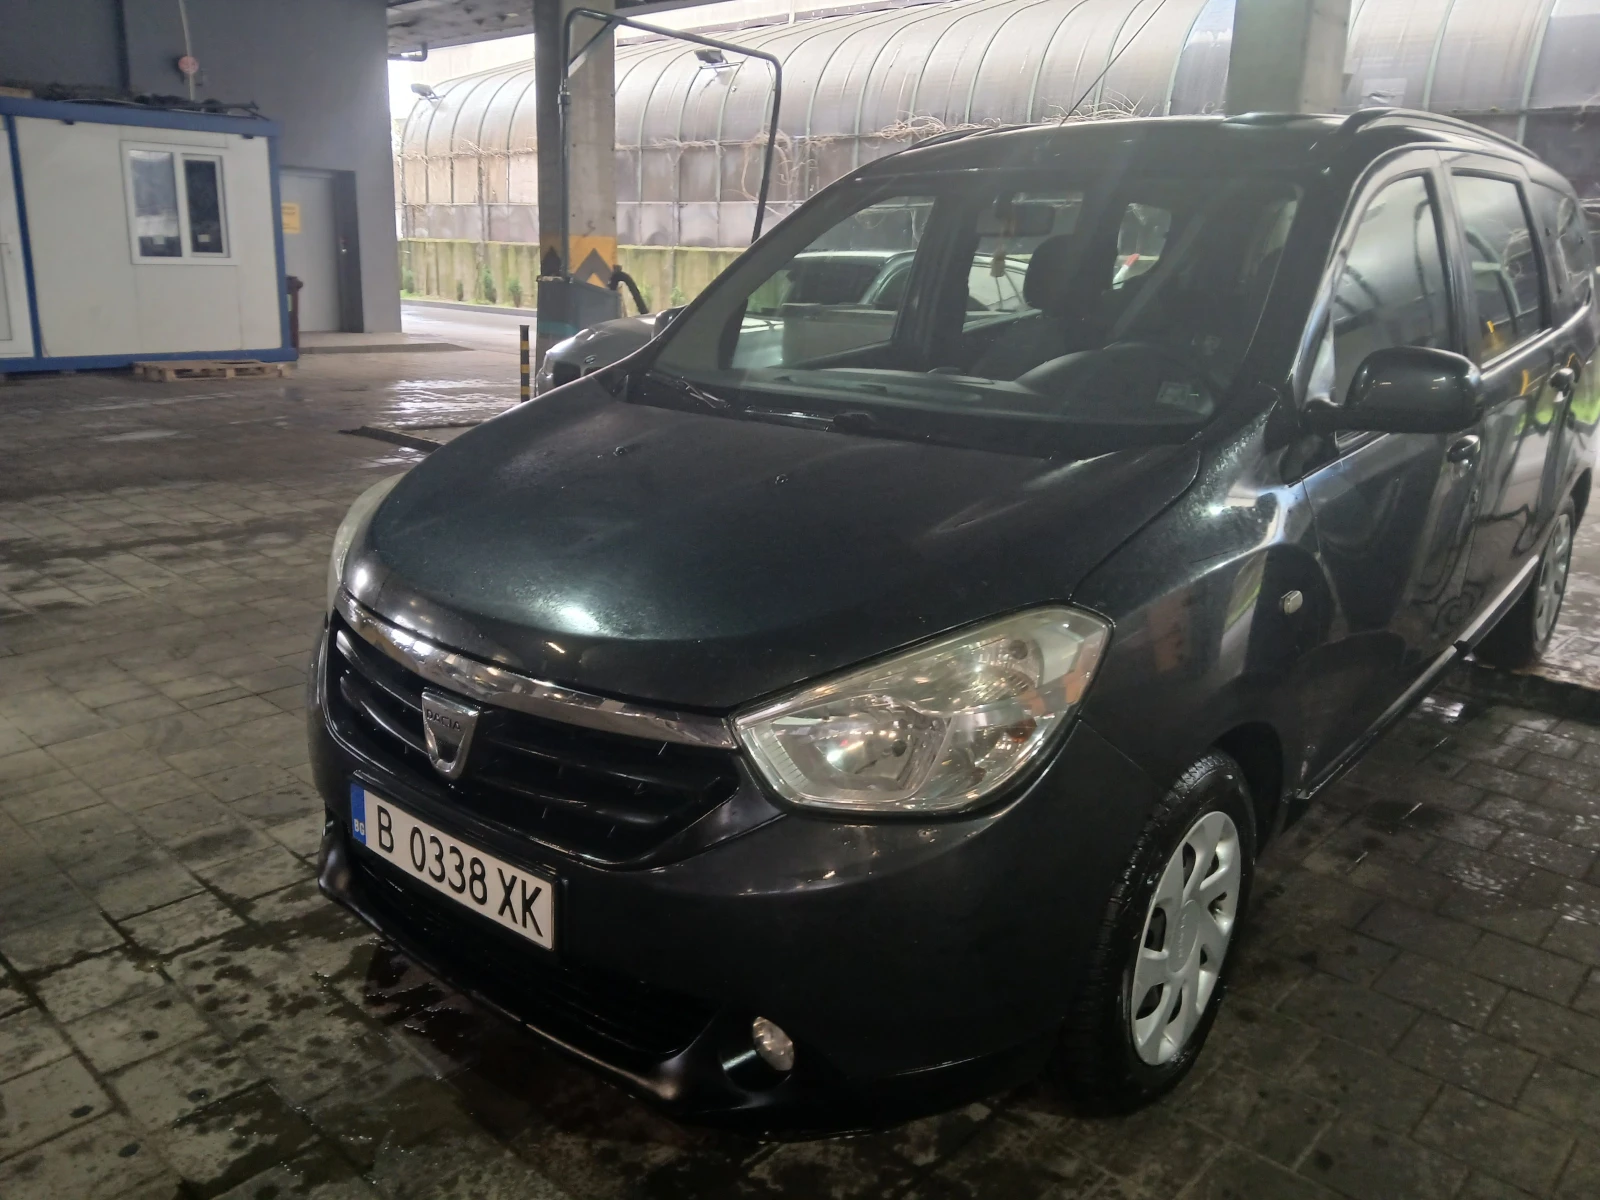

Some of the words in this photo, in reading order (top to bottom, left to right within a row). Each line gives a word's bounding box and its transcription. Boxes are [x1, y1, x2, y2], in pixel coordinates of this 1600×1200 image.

[426, 708, 462, 732] DACIA
[353, 818, 365, 836] BG
[377, 804, 394, 853] B
[410, 826, 488, 906] 0338
[497, 867, 544, 938] XK
